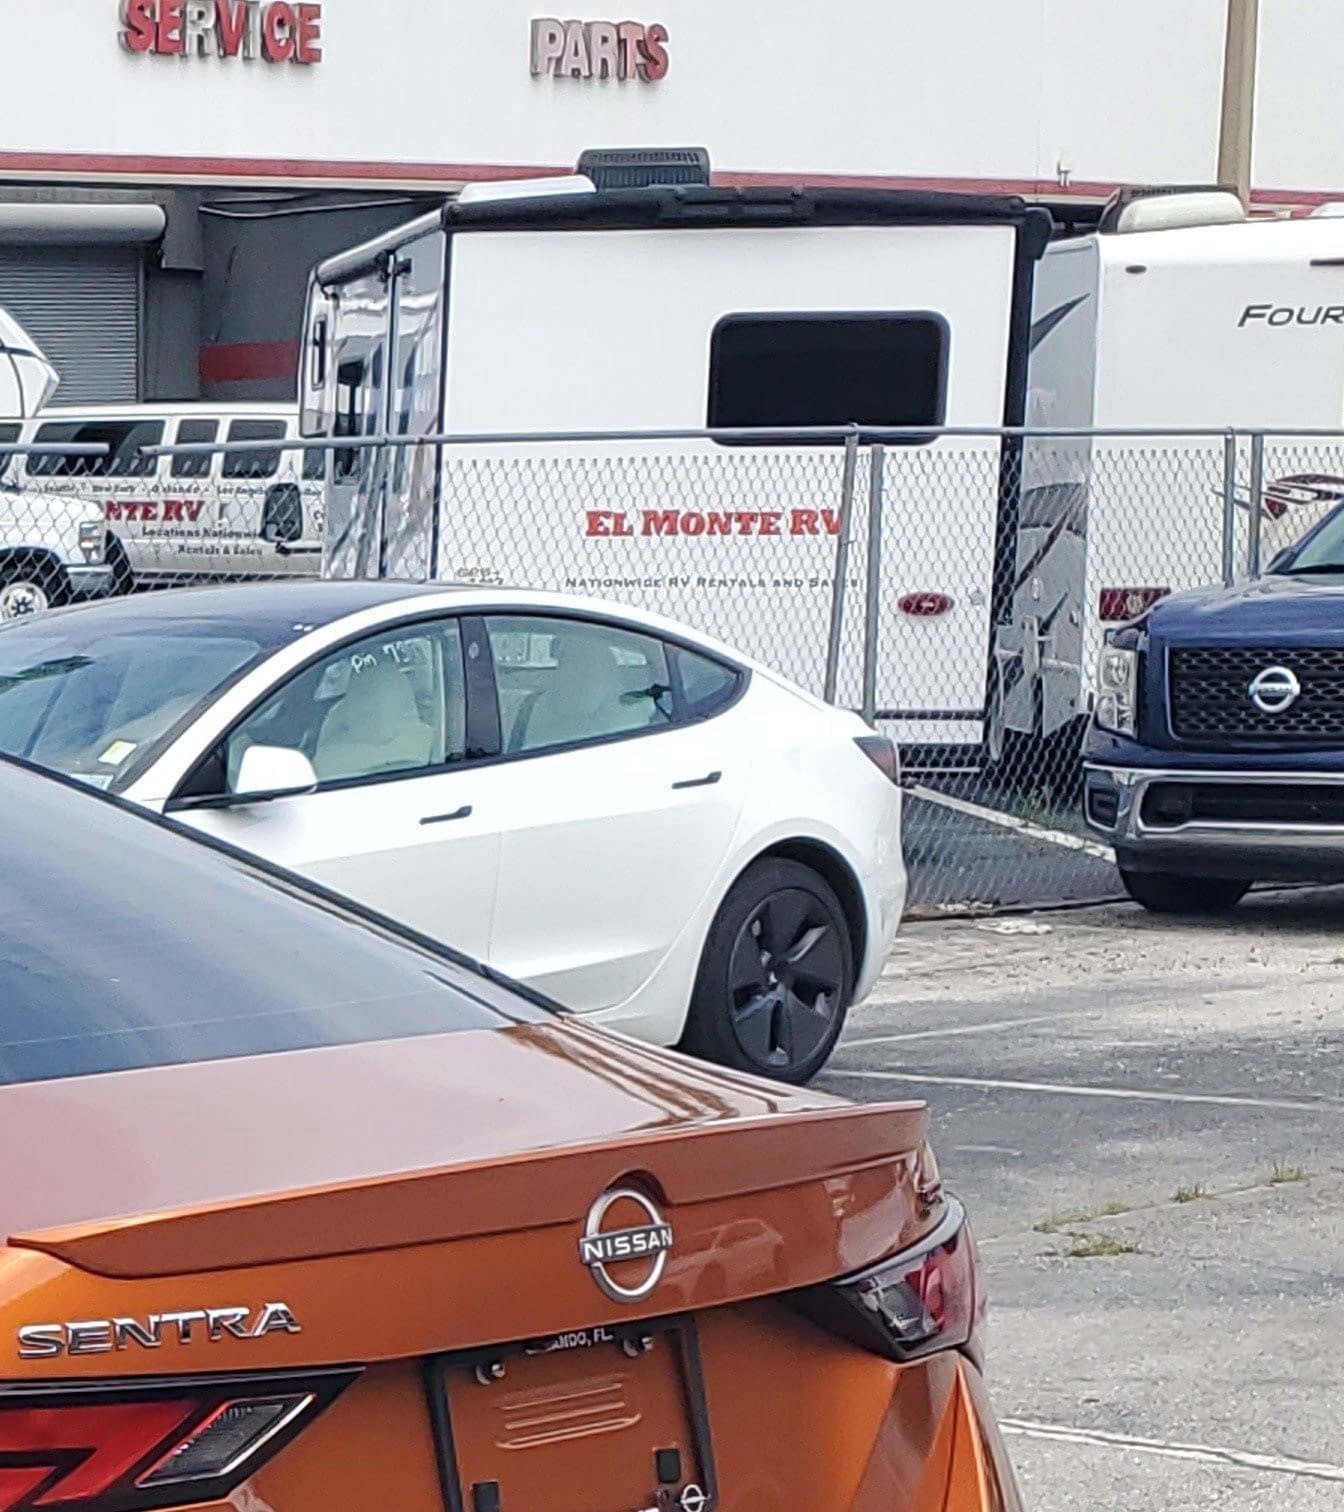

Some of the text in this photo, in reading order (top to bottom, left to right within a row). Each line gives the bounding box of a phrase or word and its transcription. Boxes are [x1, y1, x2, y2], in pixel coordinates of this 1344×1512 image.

[118, 0, 322, 63] SERVICE
[531, 18, 669, 83] PARTS
[105, 501, 205, 521] NTE RV
[585, 508, 840, 536] EL MONTE RV
[203, 526, 262, 539] Nationwi
[565, 578, 662, 588] NATIONWIDE
[668, 576, 690, 588] RV
[696, 576, 766, 588] RENTALS
[772, 578, 803, 588] AND
[583, 1228, 673, 1262] NISSAN
[18, 1301, 302, 1359] SENTRA
